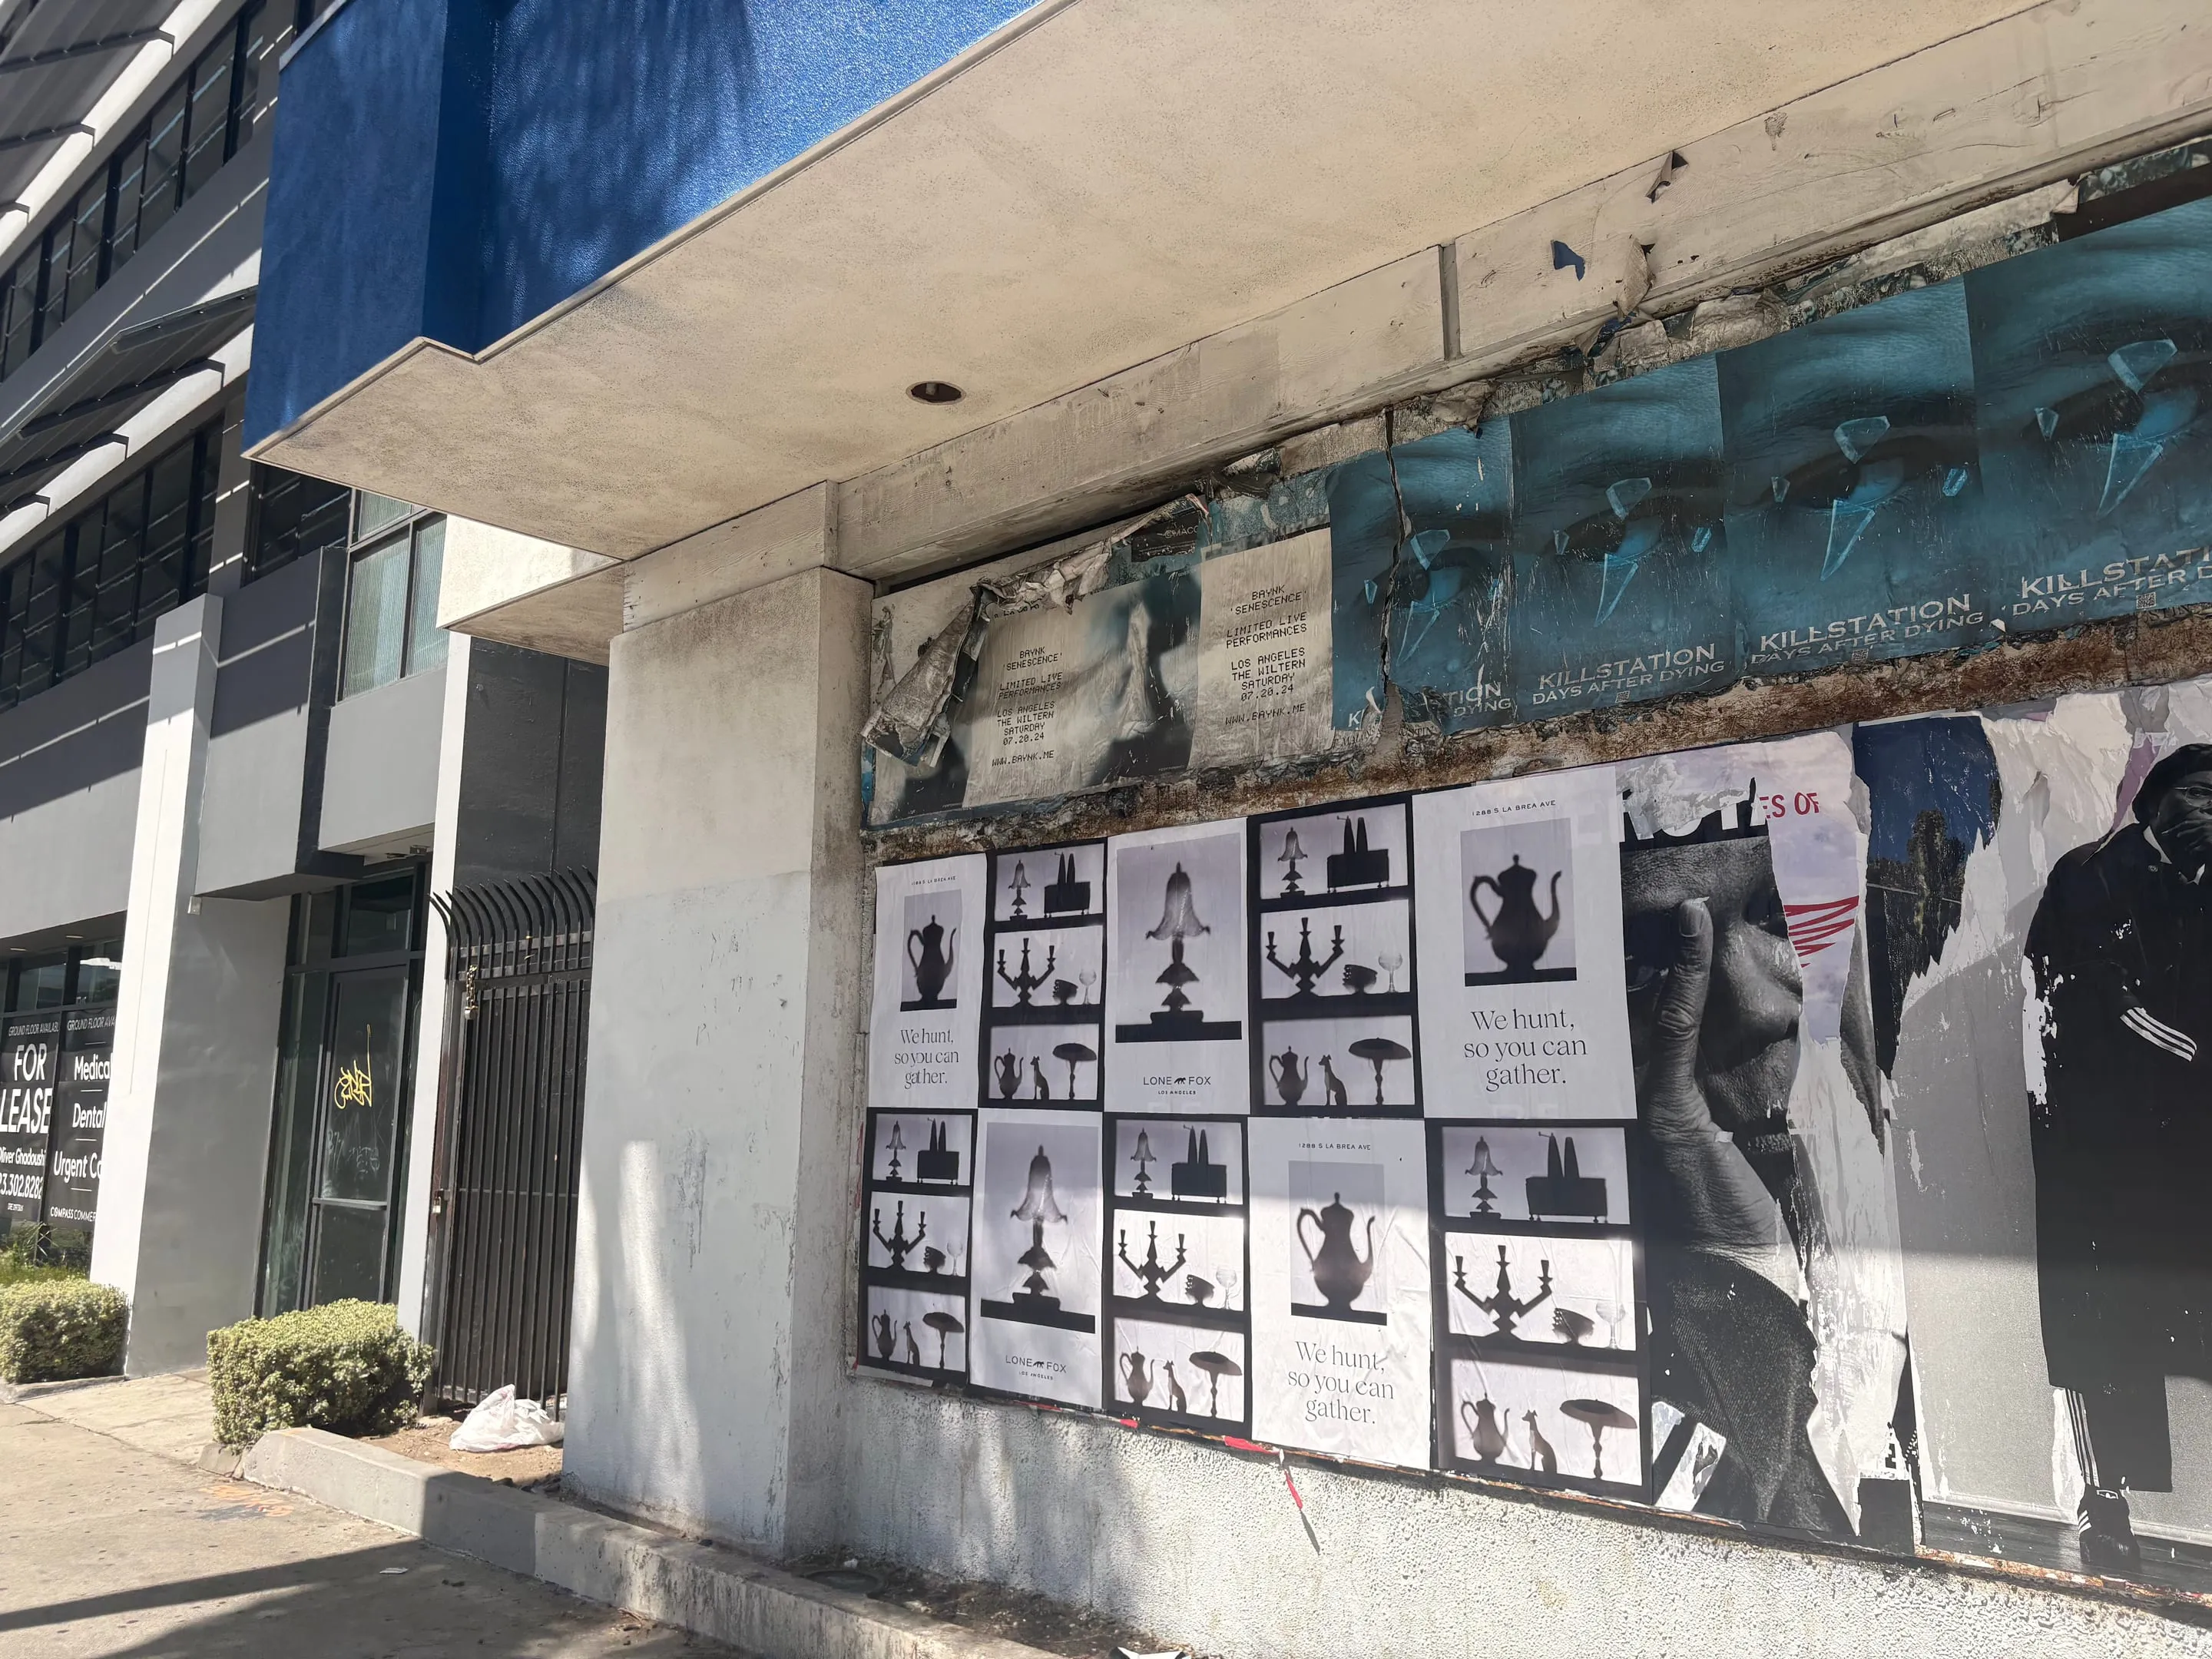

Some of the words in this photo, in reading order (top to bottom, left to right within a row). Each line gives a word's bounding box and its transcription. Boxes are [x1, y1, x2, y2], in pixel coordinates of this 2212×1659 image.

[1251, 584, 1285, 601] BAYNK
[2012, 592, 2085, 615] DAYS
[2094, 569, 2187, 600] AFTER
[1227, 619, 1273, 637] LIMITED
[1280, 611, 1306, 626] LIVE
[1760, 594, 1970, 651] KILLSTATION
[1226, 623, 1307, 649] PERFORMANCES
[1751, 647, 1811, 664] DAYS
[1818, 629, 1895, 654] AFTER
[1905, 612, 1984, 637] DYING
[1019, 646, 1045, 659] BAYNK
[1231, 658, 1251, 671] LOS
[1257, 647, 1305, 665] ANGELES
[1232, 670, 1251, 681] THE
[1258, 659, 1306, 676] WILTERN
[1538, 643, 1715, 690] KILLSTATION
[998, 681, 1061, 700] PERFORMANCES
[999, 677, 1036, 691] LIMITED
[1041, 671, 1063, 684] LIVE
[1241, 673, 1295, 690] SATURDAY
[1533, 686, 1582, 704] DAYS
[1588, 674, 1652, 694] AFTER
[1660, 661, 1725, 682] DYING
[1240, 684, 1294, 701] 07.20.24
[997, 708, 1013, 718] LOS
[1018, 700, 1055, 714] ANGELES
[997, 717, 1012, 727] THE
[1017, 710, 1055, 724] WILTERN
[1225, 703, 1306, 726] WWW.BAYNK.ME
[1002, 732, 1045, 746] 07.20.24
[1004, 721, 1045, 736] SATURDAY
[992, 750, 1055, 767] WWW.BAYNK.ME
[1515, 803, 1537, 811] BREA
[1540, 800, 1556, 808] AVE
[1471, 1010, 1508, 1031] We
[1512, 1008, 1575, 1031] hunt,
[900, 1029, 919, 1044] We
[922, 1028, 953, 1045] hunt,
[895, 1052, 909, 1065] so
[910, 1052, 932, 1068] you
[935, 1051, 959, 1063] can
[1464, 1042, 1489, 1058] so
[1495, 1041, 1536, 1063] you
[1542, 1038, 1588, 1056] can
[14, 1043, 48, 1081] FOR
[904, 1068, 948, 1089] gather.
[1143, 1076, 1172, 1085] LONE
[1188, 1076, 1211, 1085] FOX
[1485, 1063, 1566, 1092] gather.
[0, 1088, 53, 1134] LEASE
[72, 1102, 107, 1128] Dental
[53, 1151, 88, 1184] Urgent
[50, 1206, 75, 1220] COMPASS
[1005, 1355, 1032, 1367] LONE
[1046, 1361, 1067, 1373] FOX
[1295, 1341, 1327, 1363] We
[1333, 1344, 1384, 1374] hunt,
[1288, 1372, 1310, 1388] so
[1314, 1375, 1349, 1394] you
[1356, 1380, 1394, 1399] can
[1305, 1399, 1376, 1425] gather.
